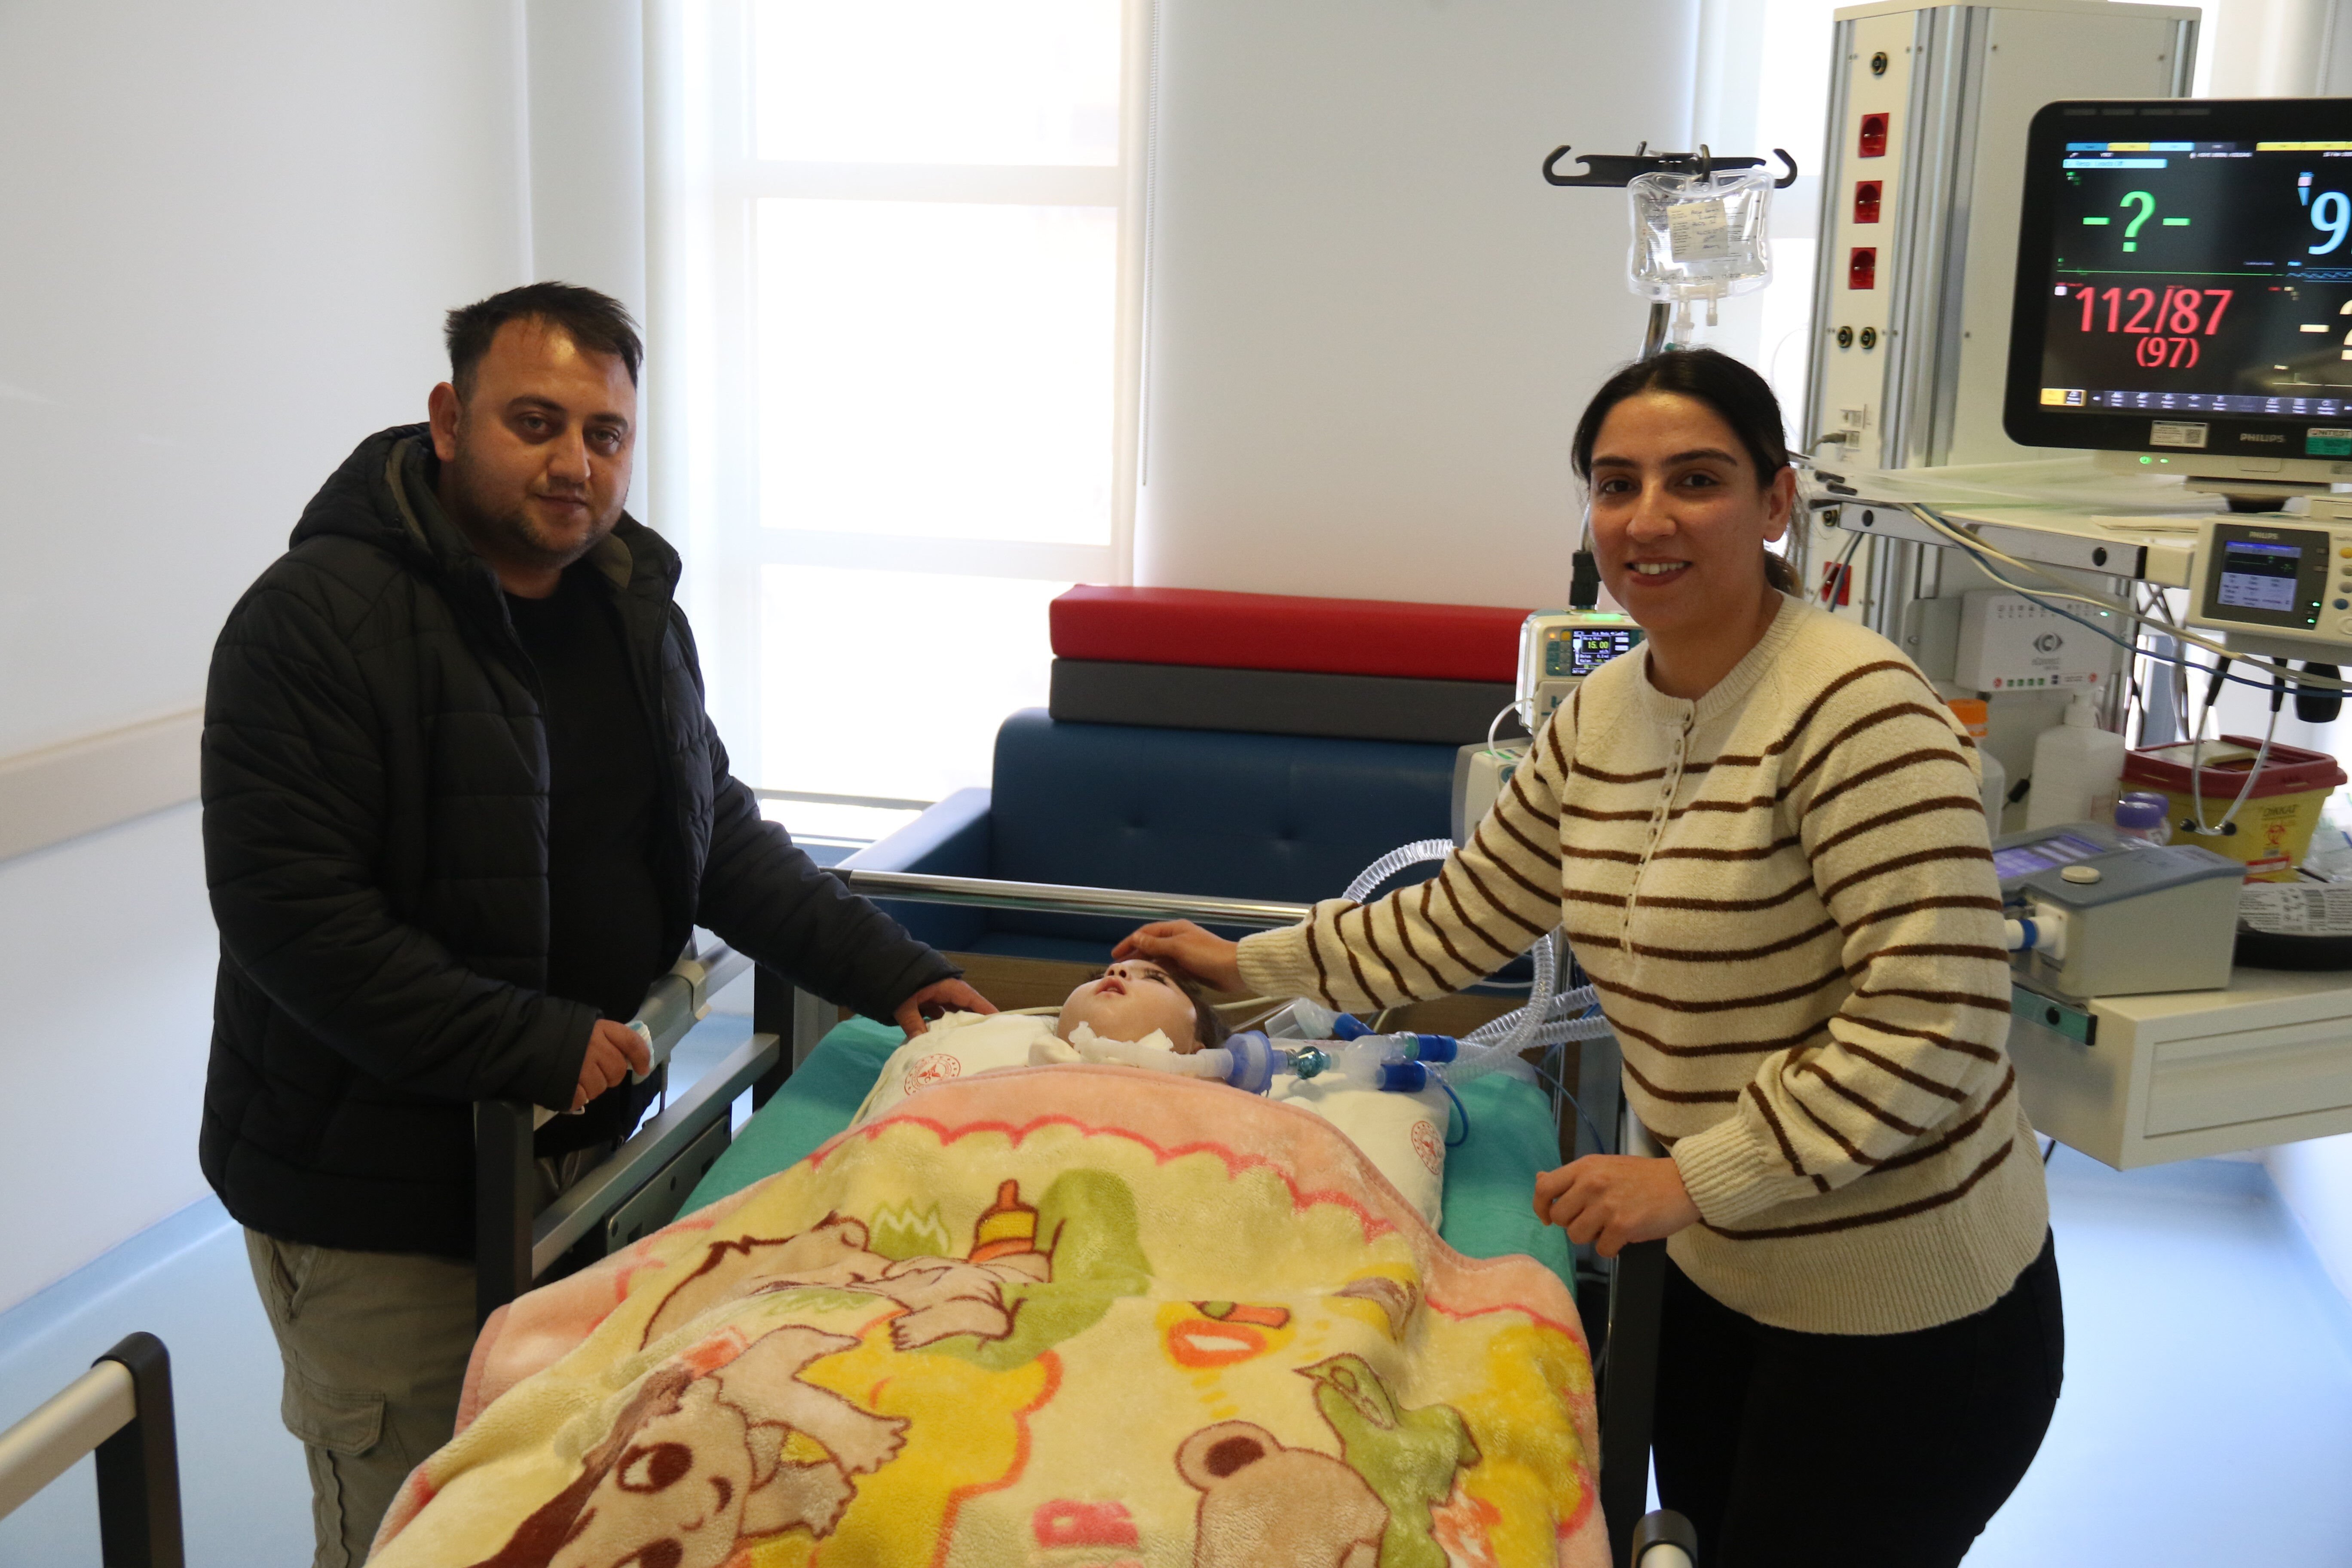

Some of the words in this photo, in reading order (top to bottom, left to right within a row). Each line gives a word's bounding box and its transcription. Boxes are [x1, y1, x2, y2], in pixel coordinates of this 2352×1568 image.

[2075, 287, 2234, 336] 112/87
[2135, 337, 2200, 369] (97)
[2239, 433, 2286, 443] PHILIPS
[1587, 640, 1609, 649] 15.00
